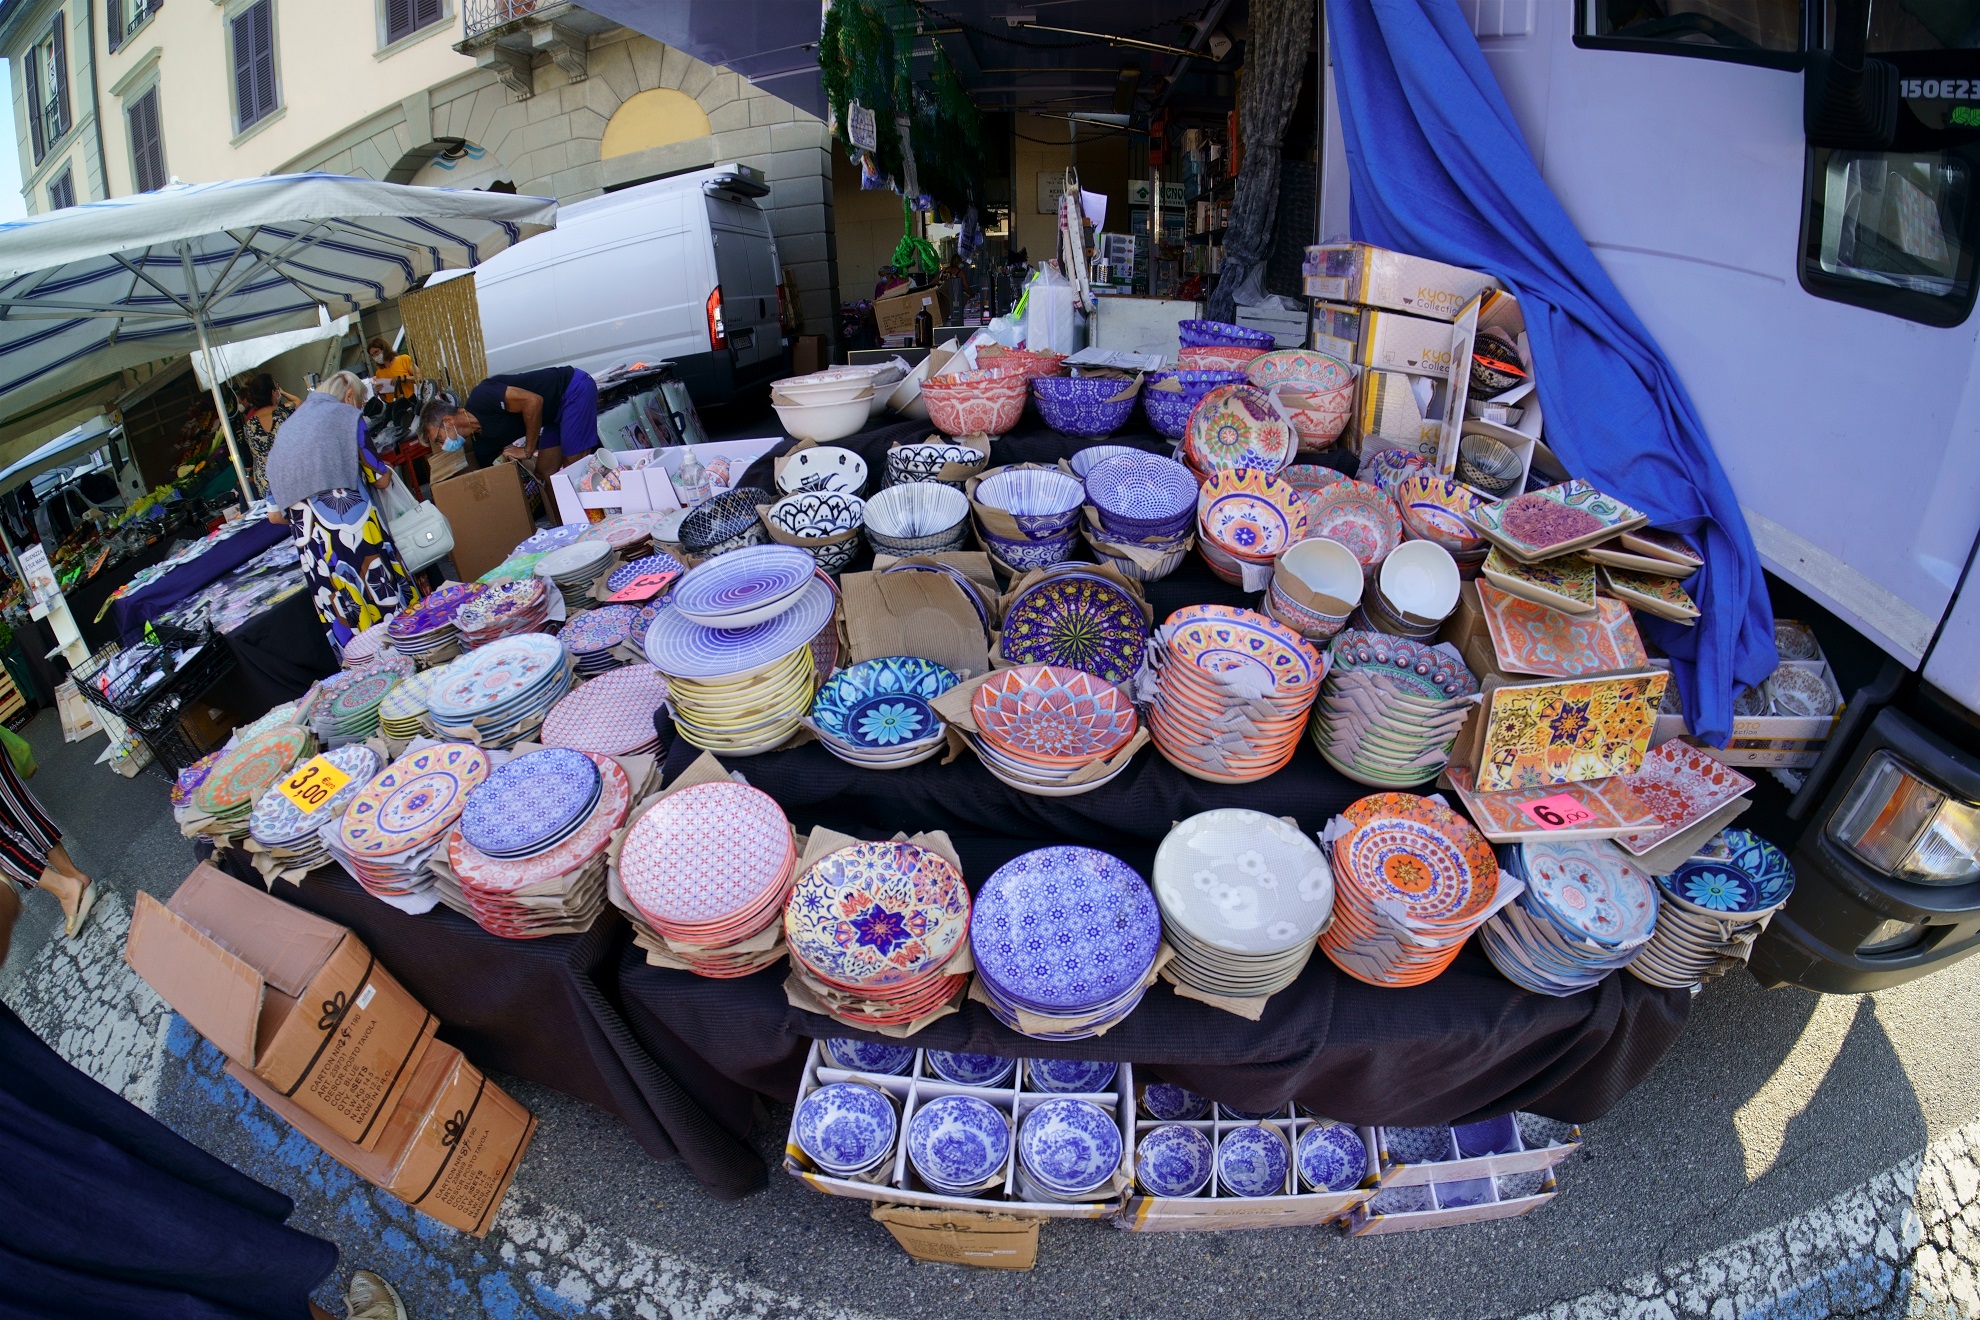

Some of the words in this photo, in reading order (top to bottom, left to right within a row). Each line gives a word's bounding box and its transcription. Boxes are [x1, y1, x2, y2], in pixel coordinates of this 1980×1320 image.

[1900, 79, 1980, 99] 150E23
[1417, 298, 1459, 316] Collectio
[1422, 348, 1452, 364] KYO
[1421, 360, 1450, 373] Collec
[1735, 722, 1760, 730] OTO
[358, 1020, 377, 1045] TAVOLA
[310, 1057, 335, 1092] CARTON
[344, 1065, 359, 1086] BLUE
[356, 1101, 372, 1124] MADE
[435, 1167, 456, 1199] CARTON
